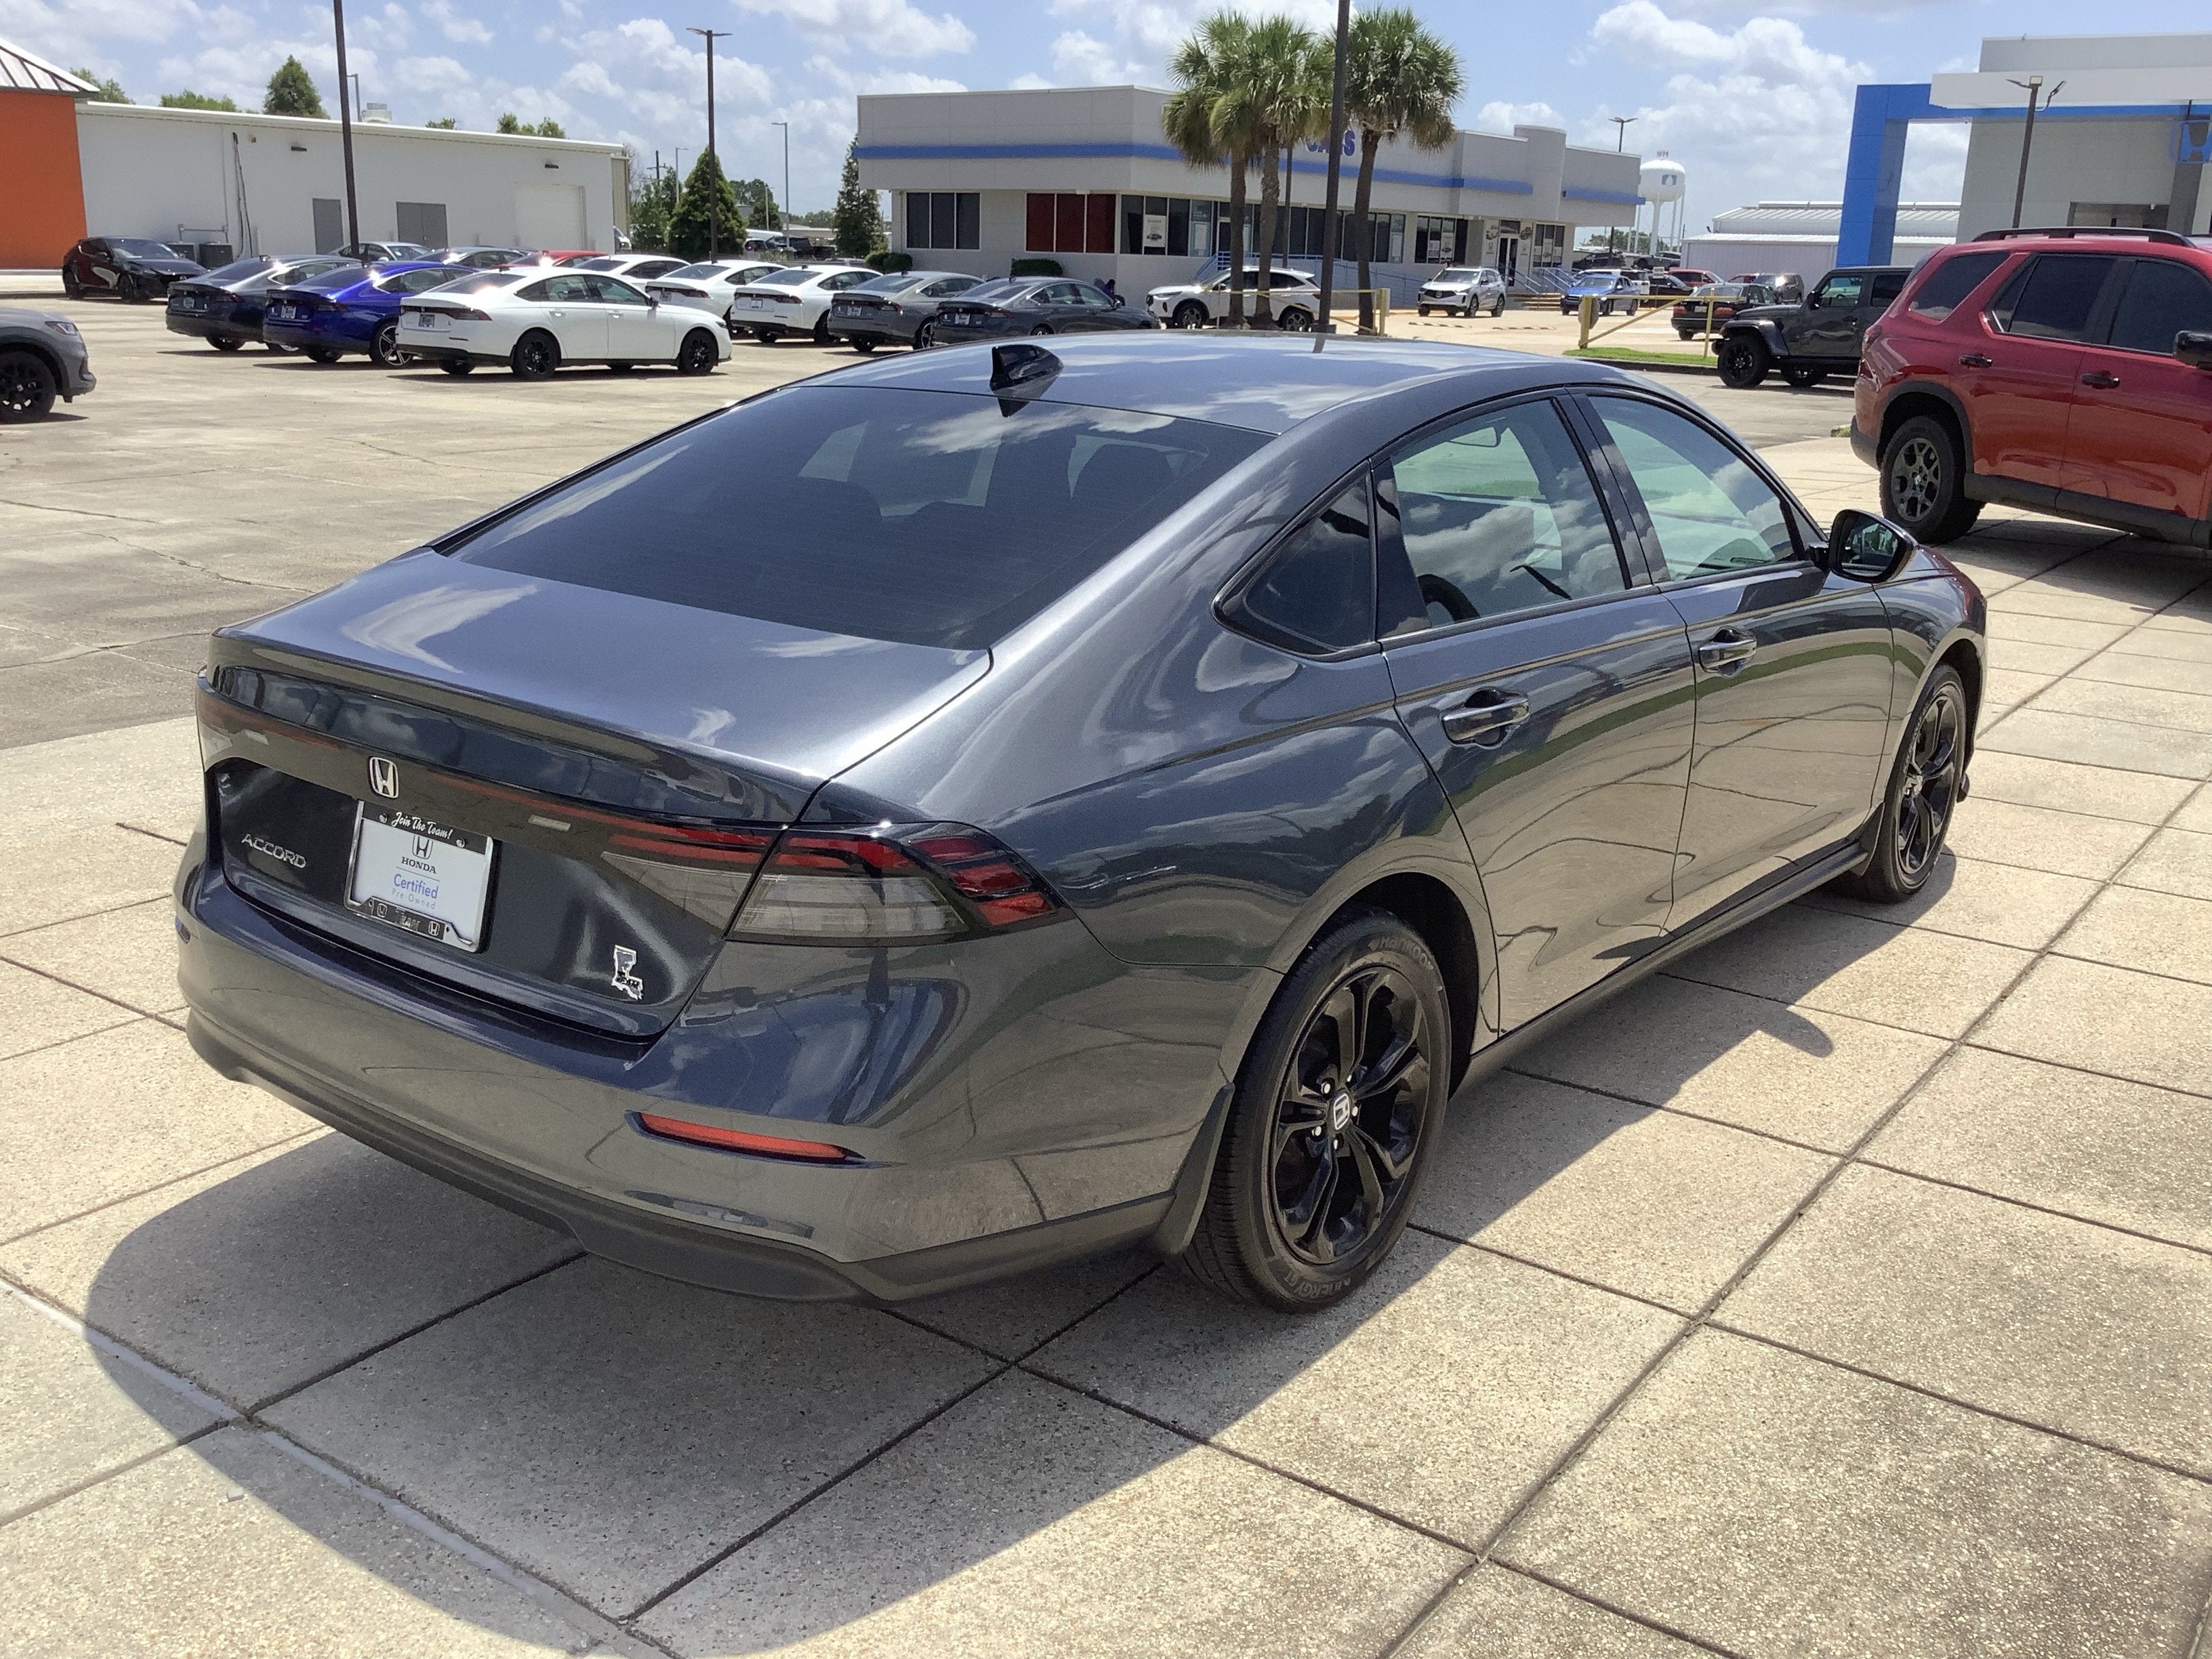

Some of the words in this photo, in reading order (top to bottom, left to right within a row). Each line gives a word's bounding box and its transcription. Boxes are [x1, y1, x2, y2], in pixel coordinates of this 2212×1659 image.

[391, 811, 411, 827] Join
[412, 817, 426, 831] The
[427, 821, 454, 840] Team!
[241, 834, 306, 869] ACCORD
[401, 857, 437, 874] HONDA
[394, 874, 438, 899] Certified
